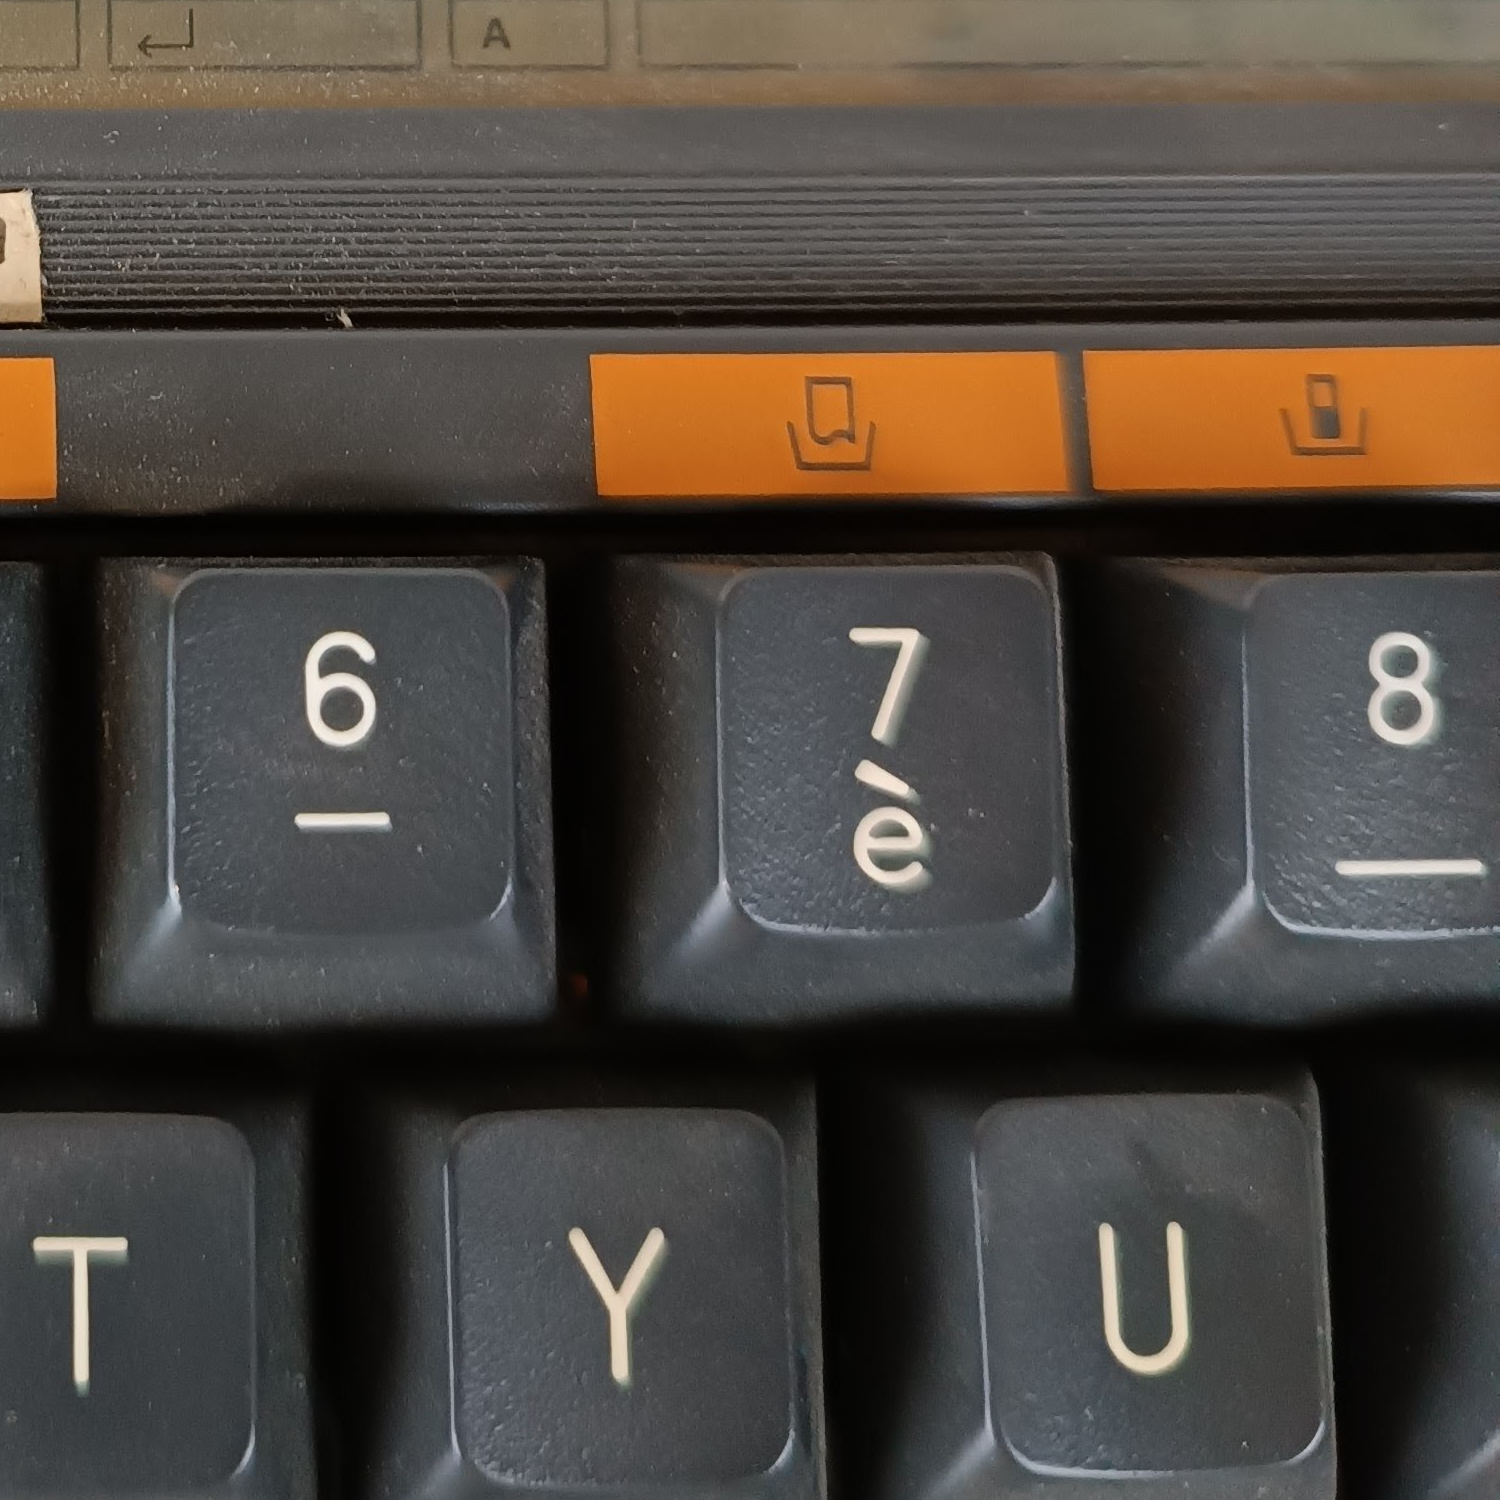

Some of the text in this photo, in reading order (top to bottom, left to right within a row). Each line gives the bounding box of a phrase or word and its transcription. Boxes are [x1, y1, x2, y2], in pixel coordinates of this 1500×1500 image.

[482, 18, 512, 49] A
[304, 630, 378, 748] 6
[848, 627, 928, 744] 7
[1367, 630, 1441, 748] 8
[852, 759, 930, 888] è
[32, 1235, 129, 1391] T
[568, 1226, 667, 1385] Y
[1098, 1220, 1190, 1376] U
